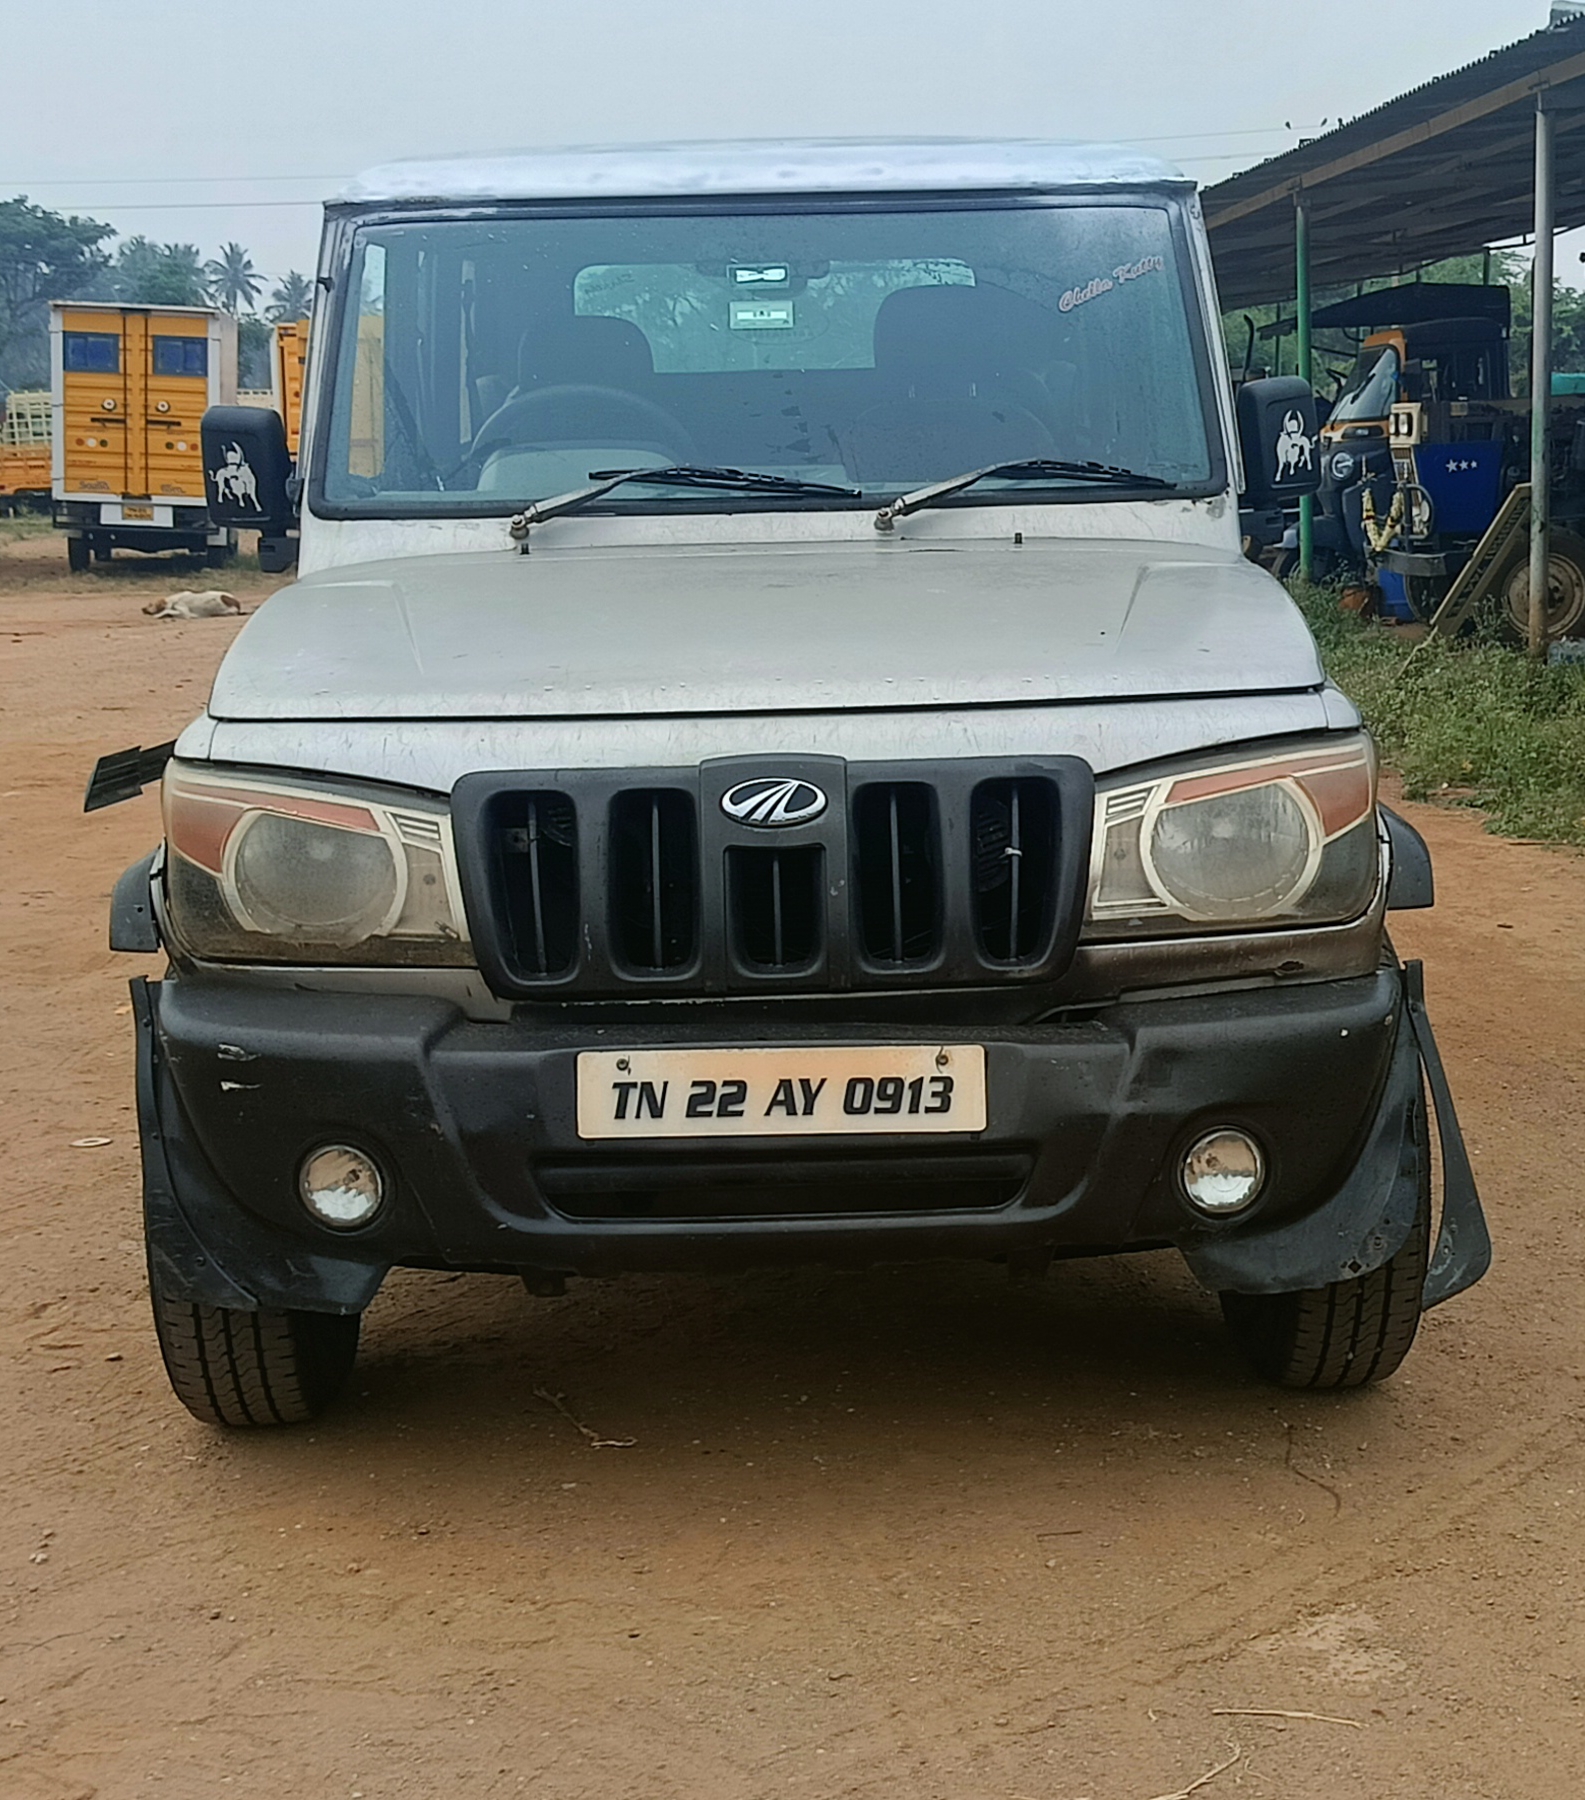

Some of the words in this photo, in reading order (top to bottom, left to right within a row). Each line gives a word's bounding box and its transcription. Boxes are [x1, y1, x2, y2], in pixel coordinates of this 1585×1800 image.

[612, 1081, 669, 1119] TN
[685, 1080, 748, 1118] 22
[764, 1078, 828, 1116] AY
[843, 1076, 954, 1115] 0913
